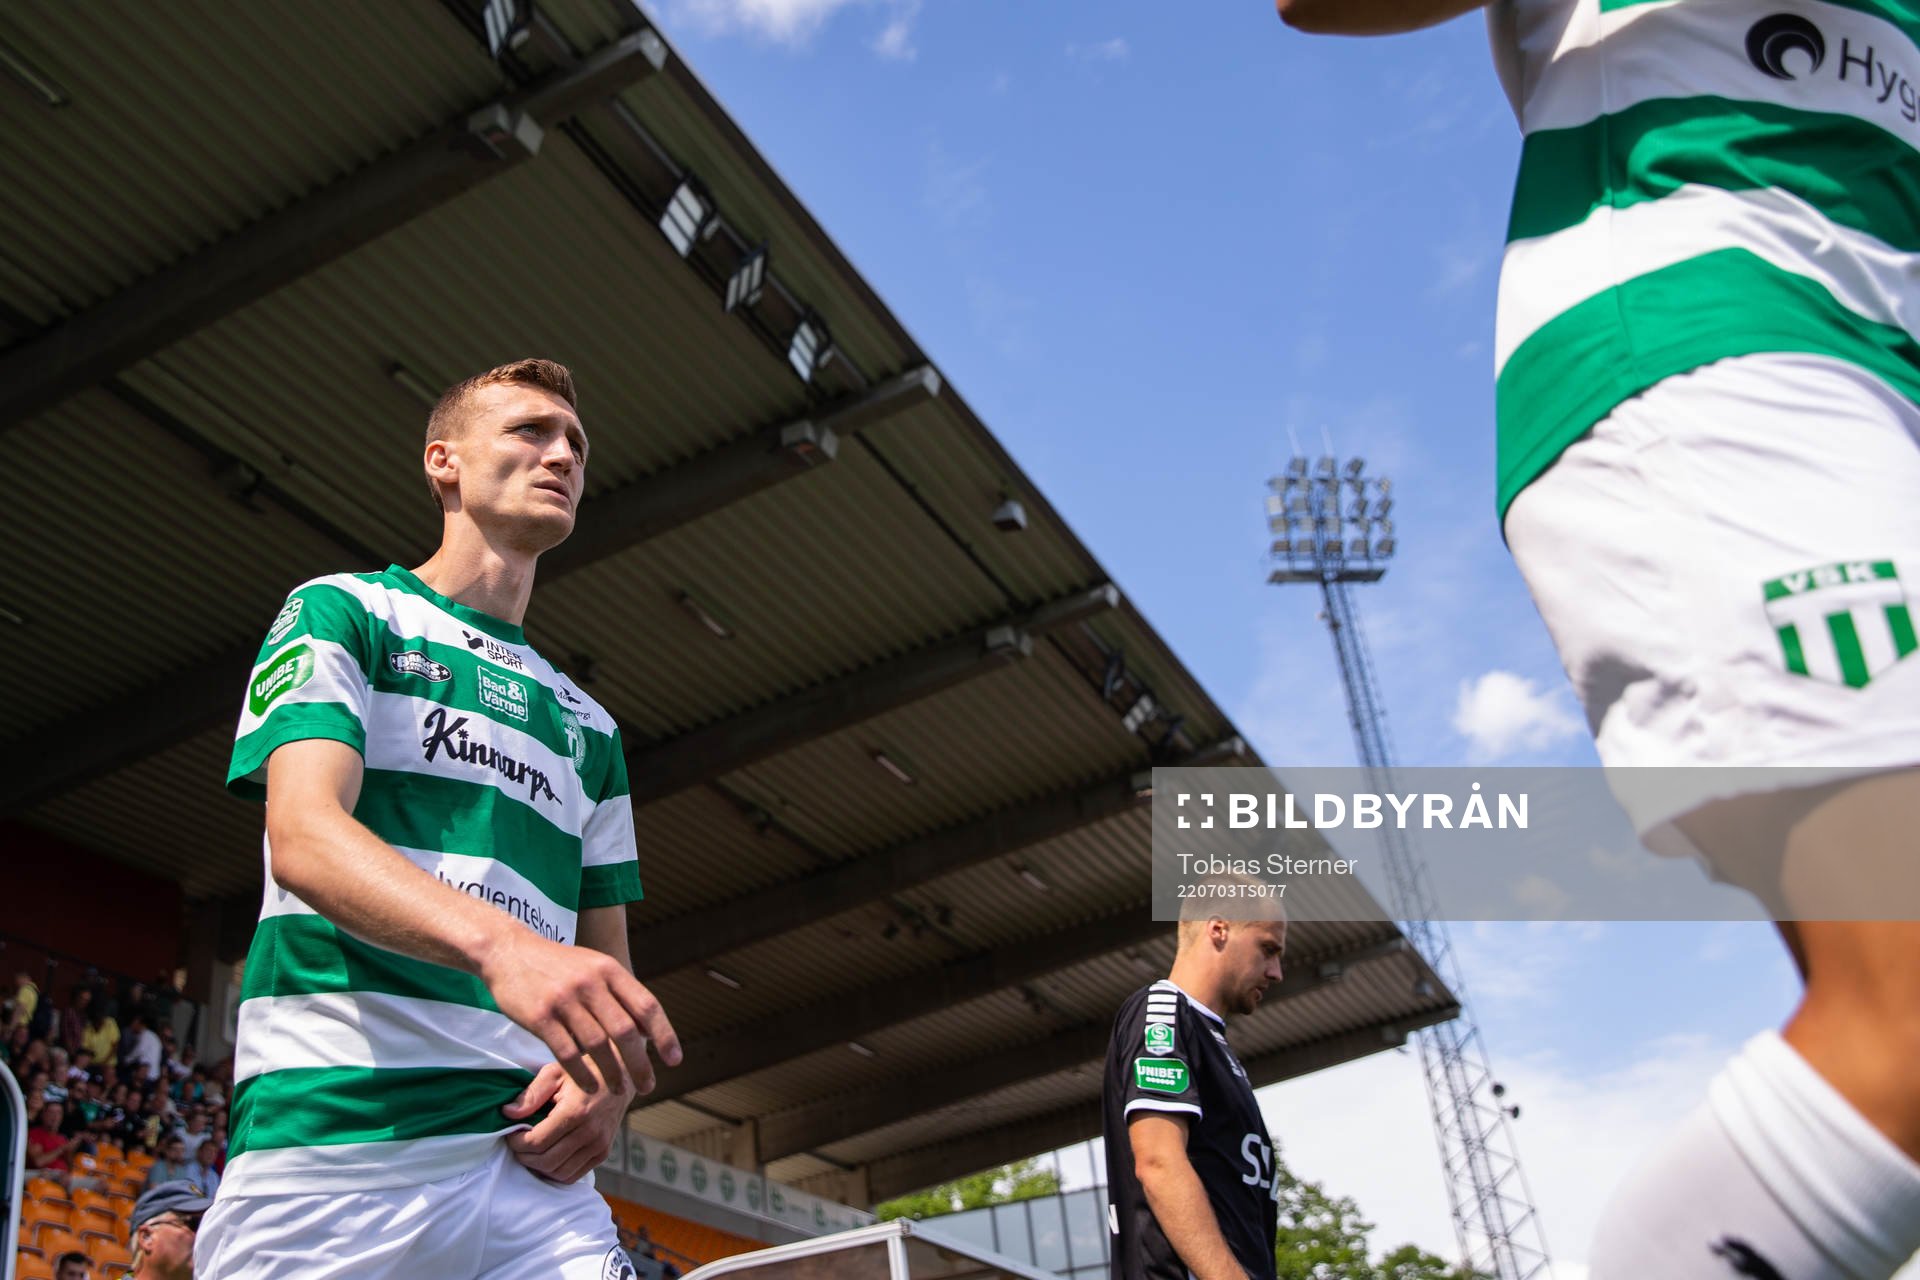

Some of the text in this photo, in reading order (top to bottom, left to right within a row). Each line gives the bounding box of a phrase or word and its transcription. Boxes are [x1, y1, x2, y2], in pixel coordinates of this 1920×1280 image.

[1838, 37, 1920, 123] Hyg
[486, 640, 522, 661] INTER
[488, 650, 523, 670] SPORT
[256, 653, 307, 697] UNIBET
[482, 676, 525, 702] Bad &
[483, 690, 525, 716] Värme
[422, 708, 562, 806] Kinnarps
[1138, 1066, 1184, 1080] UNIBET
